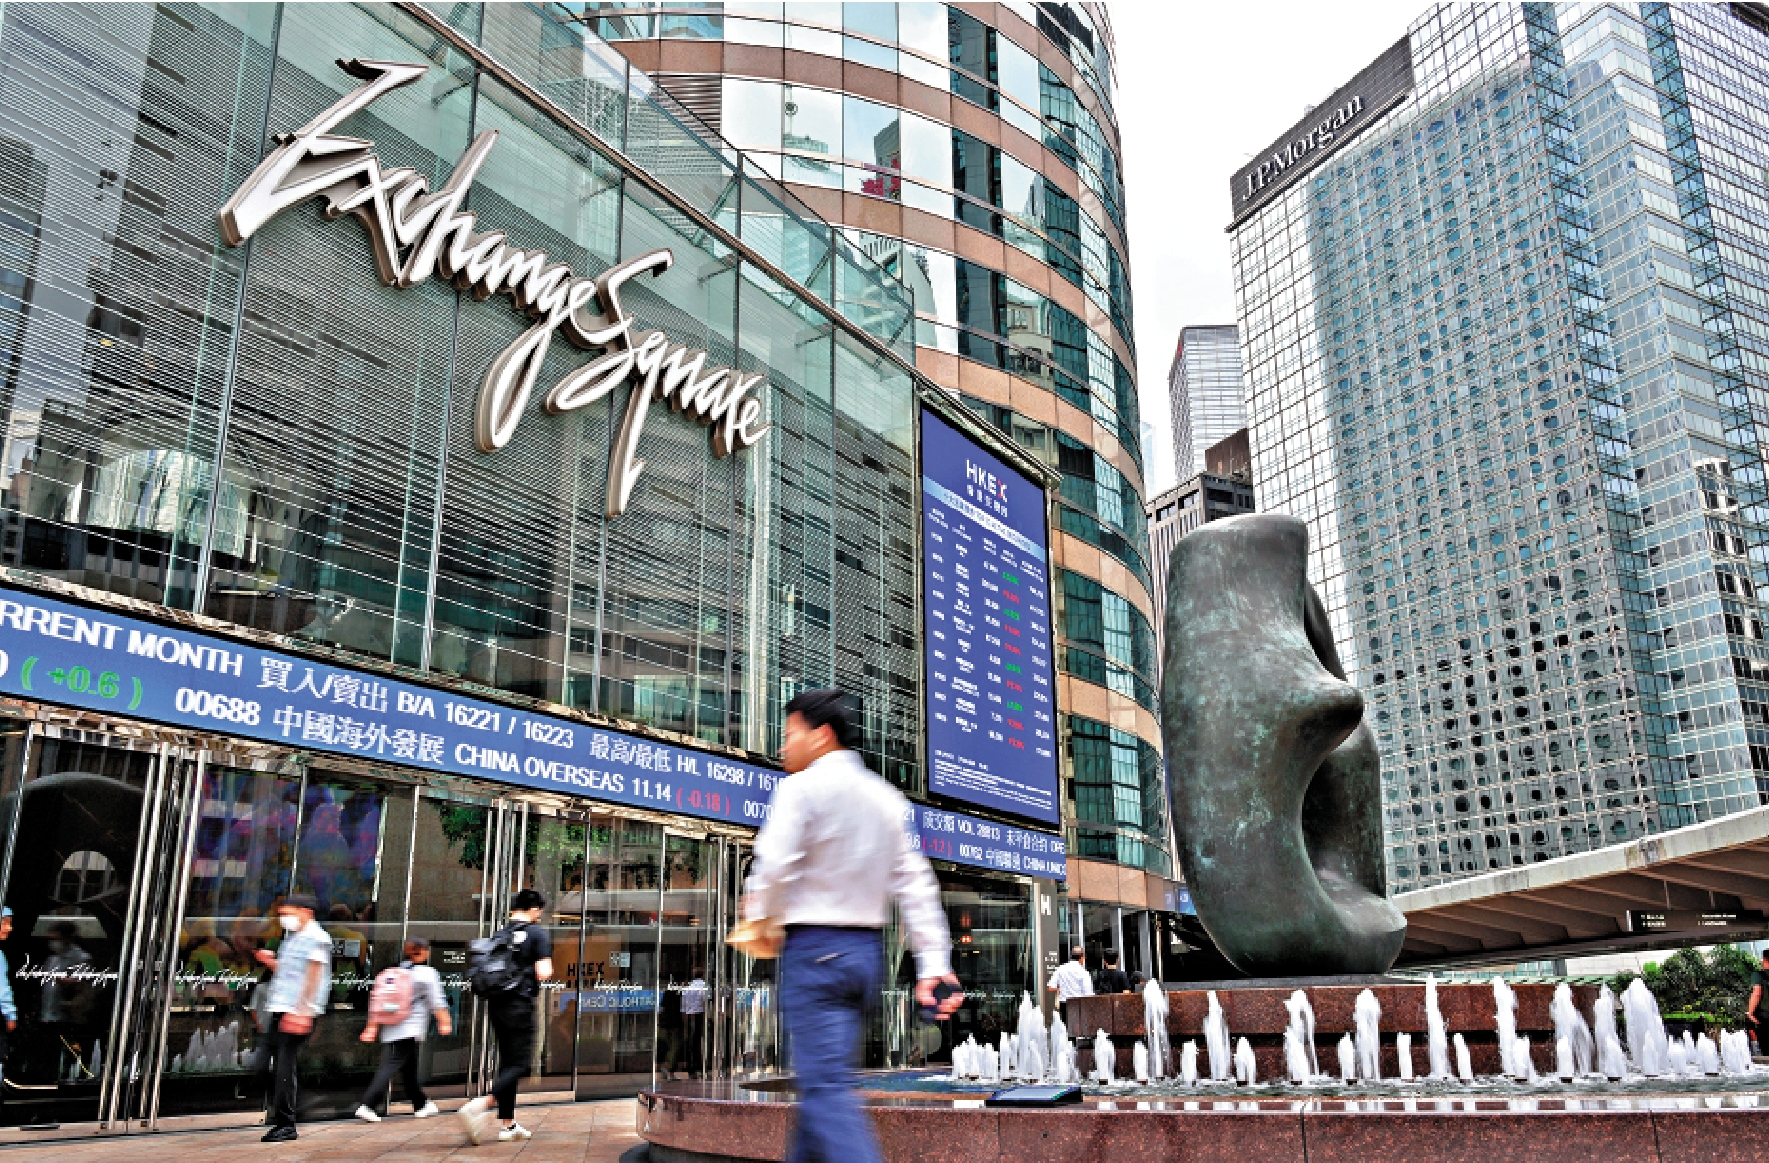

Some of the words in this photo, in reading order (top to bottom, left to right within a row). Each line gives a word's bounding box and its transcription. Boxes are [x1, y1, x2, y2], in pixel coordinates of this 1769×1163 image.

[217, 58, 602, 454] Exchange
[543, 248, 772, 520] Square
[966, 459, 1007, 502] HKEX
[0, 598, 124, 650] RRENT
[127, 629, 244, 678] MONTH
[256, 655, 388, 715] 買入/賣出
[397, 690, 437, 720] B/A
[443, 702, 502, 733] 16221
[522, 720, 574, 750] 16223
[589, 733, 673, 774] 最高/最低
[677, 757, 702, 777] H/L
[706, 760, 746, 787] 16298
[175, 686, 261, 726] 00688
[272, 704, 446, 767] 中國海外發展
[454, 742, 521, 775] CHINA
[523, 756, 625, 794] OVERSEAS
[632, 777, 672, 802] 11.14
[744, 799, 774, 822] 0070
